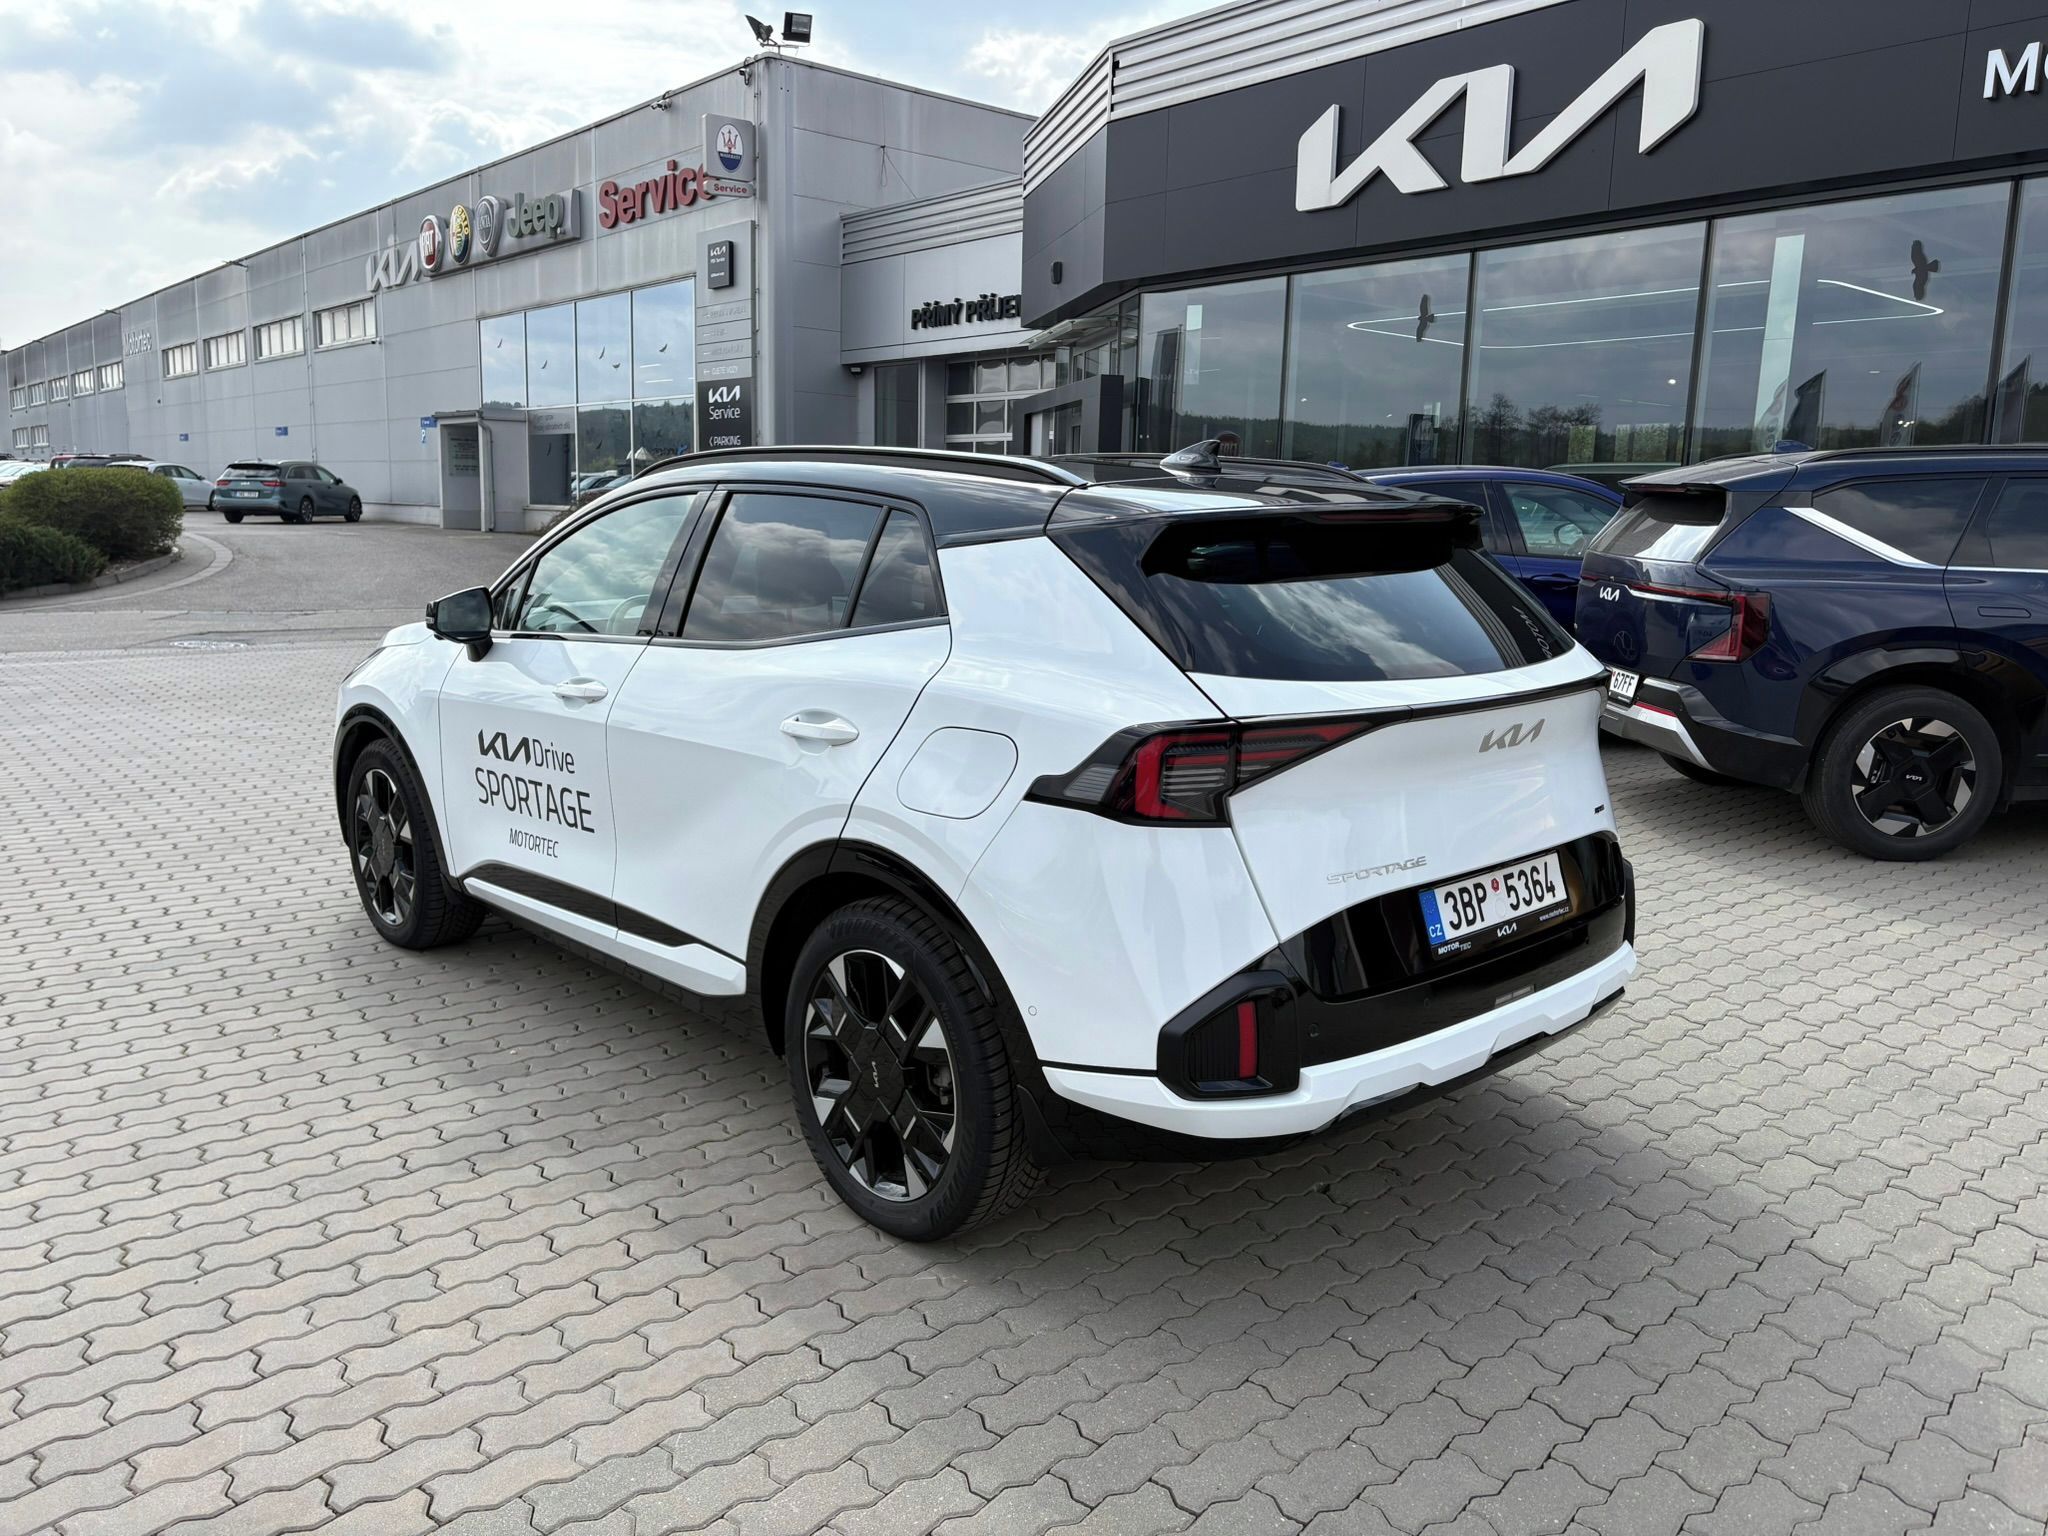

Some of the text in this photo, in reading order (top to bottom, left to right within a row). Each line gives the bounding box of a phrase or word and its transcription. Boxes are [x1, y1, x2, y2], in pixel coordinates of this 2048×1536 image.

[1983, 41, 2048, 99] M
[1296, 18, 1704, 212] KIA
[714, 183, 747, 194] Service
[507, 192, 563, 240] Jeep
[366, 241, 421, 292] KIA
[965, 293, 1021, 323] PŘÍJE
[708, 385, 741, 404] KIA
[709, 405, 741, 420] Service
[713, 435, 741, 446] PARKING
[1600, 586, 1620, 602] KIA
[1613, 670, 1636, 694] 67FF
[1479, 718, 1546, 753] KIA
[478, 728, 576, 775] KIA Drive
[474, 766, 596, 834] SPORTAGE
[509, 827, 559, 858] MOTORTEC
[1326, 855, 1428, 886] SPORTAGE
[1443, 861, 1557, 932] 3BP 5364
[1429, 924, 1444, 938] CZ
[1497, 922, 1518, 938] KIA
